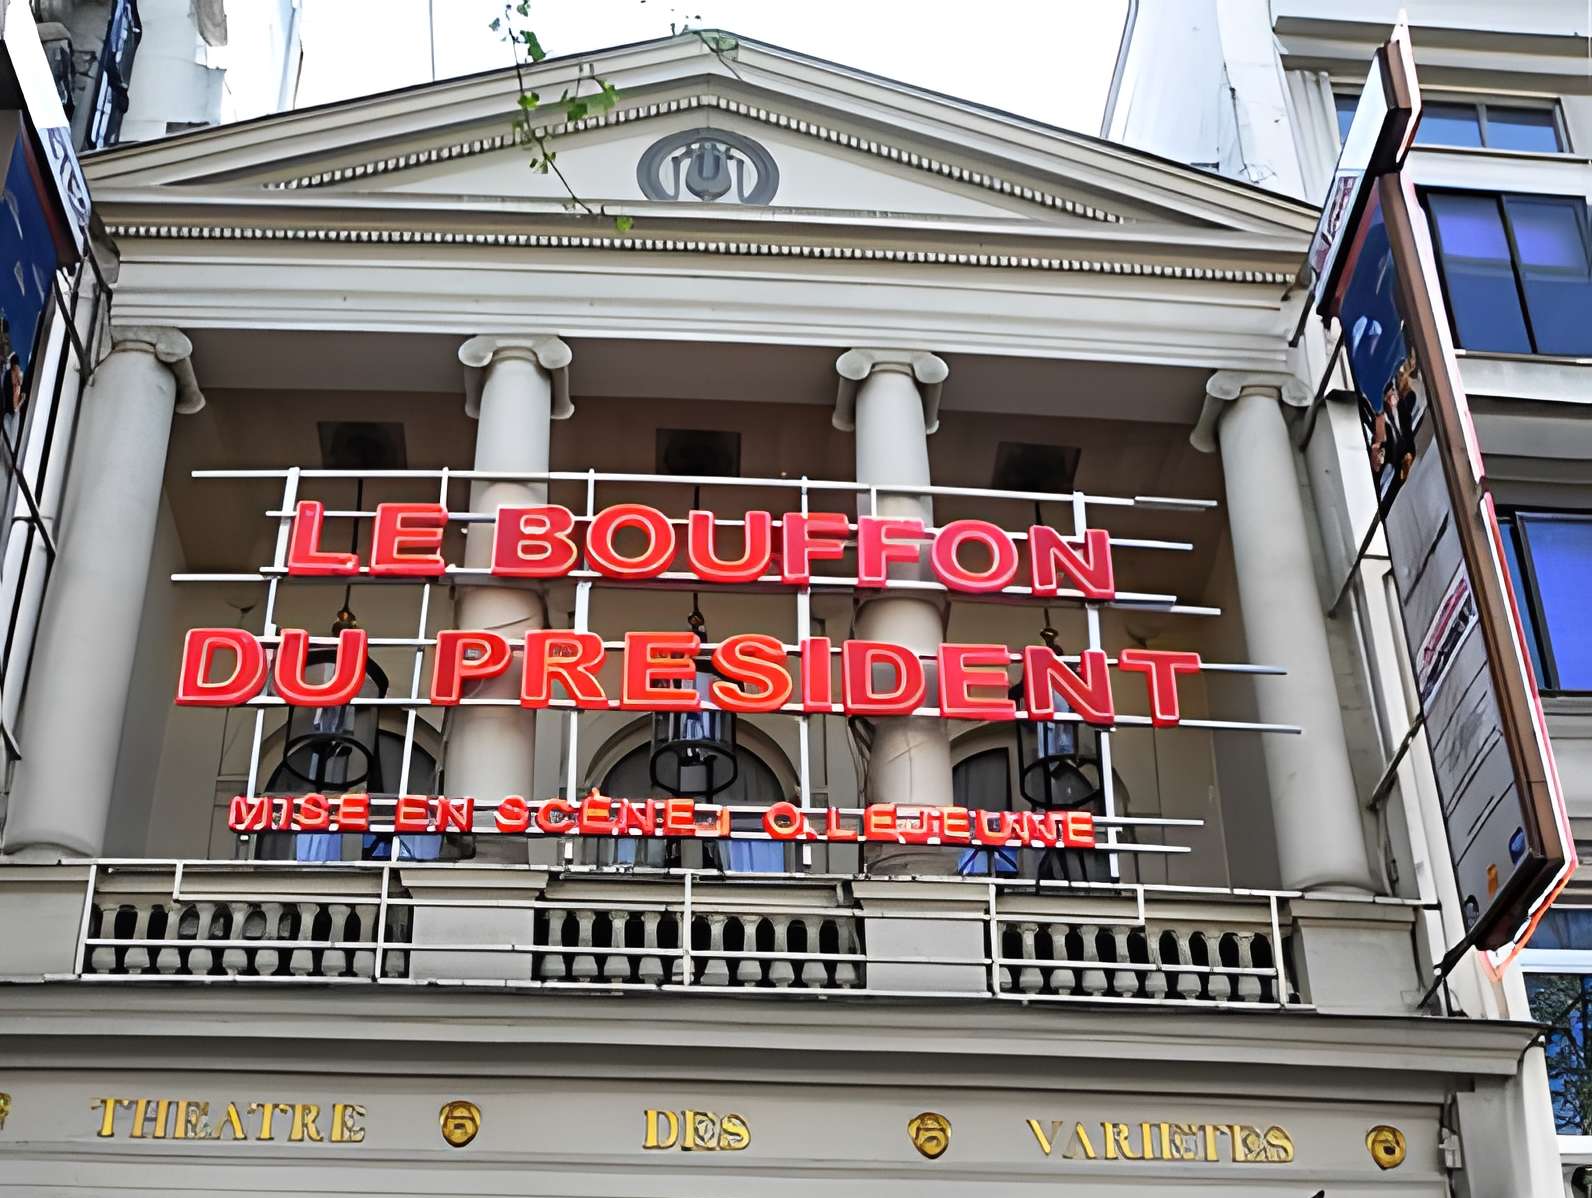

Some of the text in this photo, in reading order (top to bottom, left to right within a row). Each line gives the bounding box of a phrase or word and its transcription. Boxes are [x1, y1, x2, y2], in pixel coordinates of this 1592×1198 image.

[287, 500, 1116, 600] LE BOUFFON
[175, 627, 1202, 729] DU PRESIDENT
[228, 792, 370, 833] MISE
[394, 794, 474, 835] EN
[642, 1109, 752, 1152] DES
